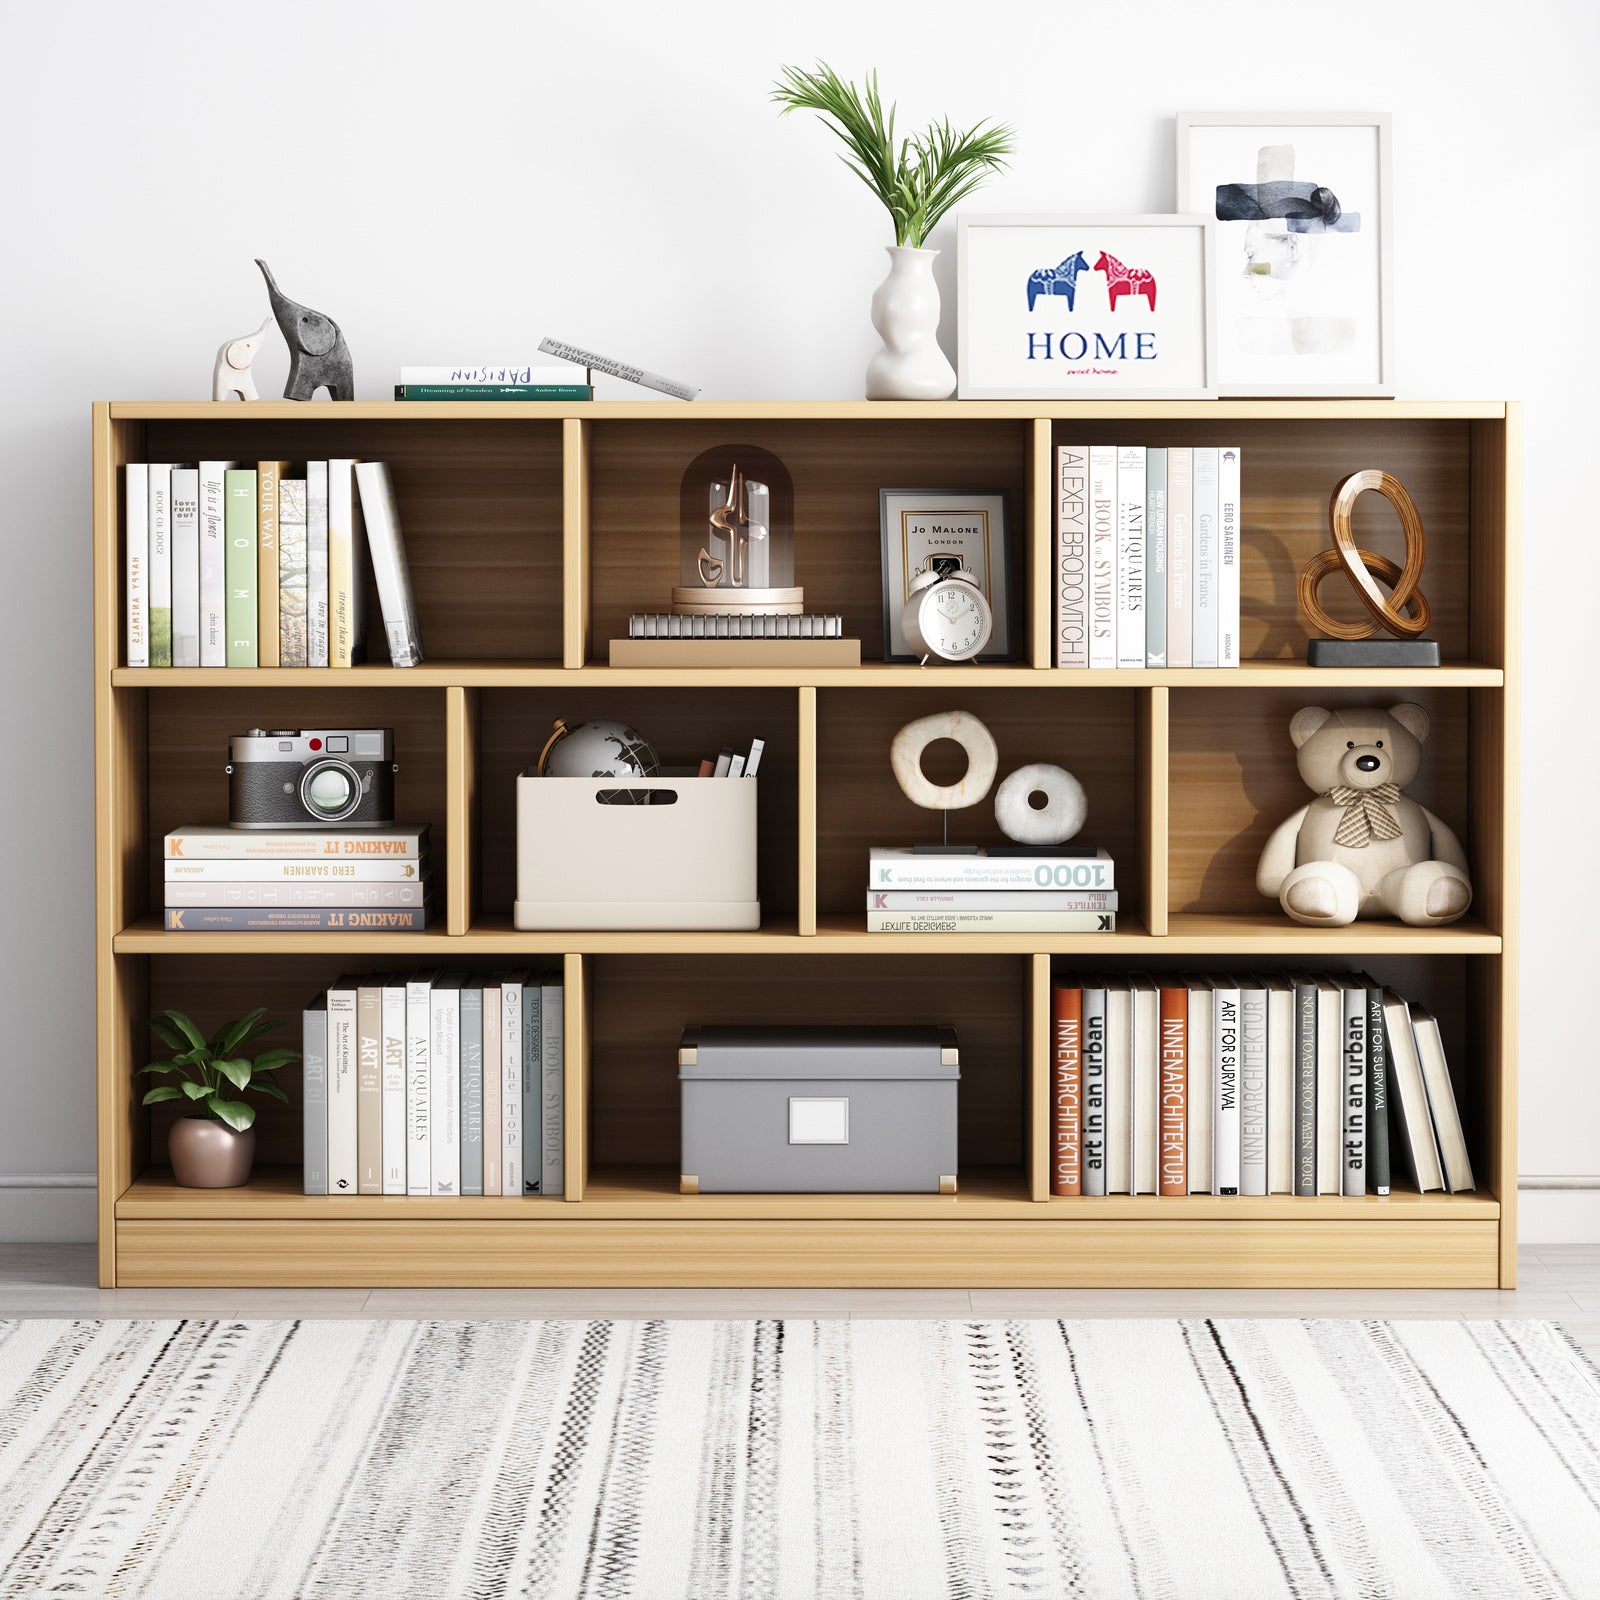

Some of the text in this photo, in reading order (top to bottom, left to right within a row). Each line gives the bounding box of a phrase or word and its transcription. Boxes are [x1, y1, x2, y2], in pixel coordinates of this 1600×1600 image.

[546, 339, 644, 377] DER PRIMZAHLEN
[1026, 332, 1158, 360] HOME
[451, 366, 531, 386] PARISIAN
[551, 349, 641, 384] DIE EINSAMKEIT
[1092, 367, 1118, 375] home
[203, 480, 221, 494] life
[1094, 480, 1103, 495] THE
[203, 512, 221, 539] flower
[262, 471, 274, 550] YOUR WAY
[1094, 500, 1111, 543] BOOK
[912, 526, 979, 534] JO MALONE
[1156, 489, 1164, 573] NEW URBAN HOUSING
[1224, 503, 1233, 565] EERO SAARINEN
[1062, 451, 1084, 654] ALEXEY BRODOVITCH
[1094, 547, 1103, 557] OF
[1125, 503, 1142, 611] ANTIQUAIRES
[1174, 513, 1187, 609] Gardens in France
[1199, 513, 1213, 608] Gardens in France
[938, 595, 944, 603] 11
[947, 591, 956, 600] 12
[969, 604, 975, 612] 2
[1094, 560, 1112, 638] SYMBOLS
[209, 613, 219, 646] chris choice
[316, 601, 327, 658] love in prague
[336, 591, 348, 660] stronger than sin
[971, 629, 977, 638] 4
[940, 639, 945, 647] 7
[952, 642, 958, 650] 6
[964, 639, 970, 647] 5
[170, 839, 184, 857] K
[324, 841, 407, 854] MAKING IT
[283, 866, 355, 876] EERO SAARINEN
[880, 868, 892, 883] K
[1033, 864, 1106, 887] 1000
[227, 888, 414, 902] Over the Top
[875, 894, 888, 909] K
[1067, 901, 1107, 910] TEXTILES
[171, 910, 185, 929] K
[327, 913, 413, 926] MAKING IT
[435, 1008, 443, 1030] Virginia
[446, 1007, 454, 1025] Detail
[531, 999, 540, 1063] TEXTILE DESIGNERS
[545, 1017, 553, 1031] THE
[341, 1051, 349, 1074] Knitting
[361, 1036, 378, 1069] ART
[386, 1036, 403, 1069] ART
[445, 1033, 454, 1074] Contemporary
[506, 991, 517, 1145] Over the Top
[545, 1036, 560, 1077] BOOK
[1221, 1001, 1236, 1111] ART FOR SURVIVAL
[1371, 1001, 1385, 1111] ART FOR SURVIVAL
[306, 1054, 324, 1084] ART
[1243, 1001, 1264, 1165] INNENARCHITEKTUR
[413, 1037, 427, 1141] ANTIQUAIRES
[446, 1075, 454, 1107] Residential
[466, 1041, 480, 1143] ANTIQUAIRES
[487, 1071, 498, 1125] BORDEAUX
[545, 1081, 553, 1090] OF
[1083, 1016, 1102, 1169] art in an urban
[1302, 996, 1314, 1188] DIOR. NEW LOOK REVOLUTION
[1343, 1016, 1363, 1170] art in an urban
[1058, 1019, 1078, 1185] INNENARCHITEKTUR
[1163, 1019, 1184, 1185] INNENARCHITEKTUR
[446, 1109, 454, 1144] Architecture
[545, 1093, 560, 1166] SYMBOLS
[438, 1181, 452, 1192] K
[526, 1180, 540, 1191] K
